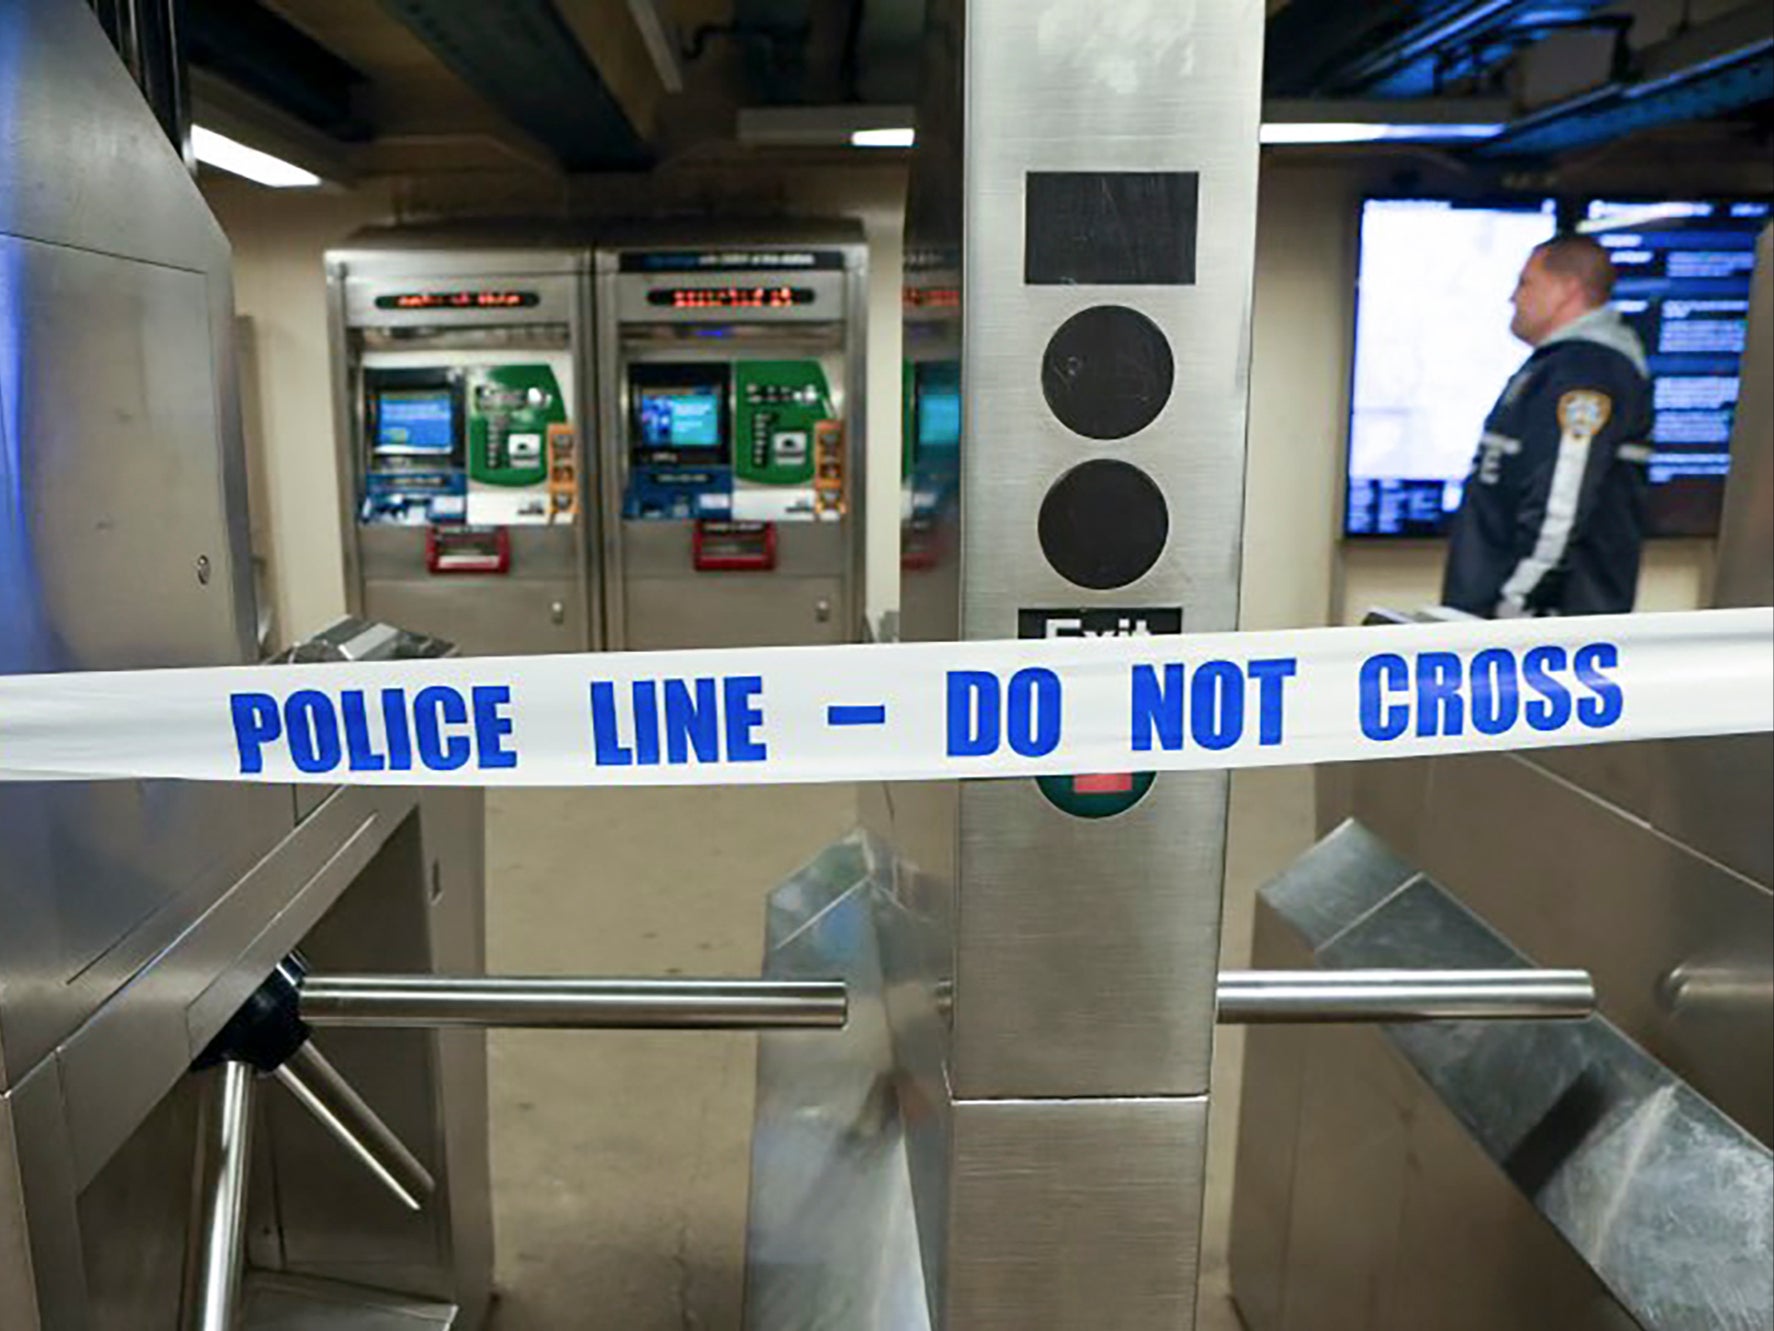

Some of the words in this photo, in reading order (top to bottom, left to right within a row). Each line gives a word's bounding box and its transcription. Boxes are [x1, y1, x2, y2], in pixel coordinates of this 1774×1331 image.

[229, 685, 518, 775] POLICE
[590, 675, 768, 767] LINE
[946, 665, 1063, 758] DO
[1130, 656, 1298, 752] NOT
[1358, 641, 1624, 742] CROSS
